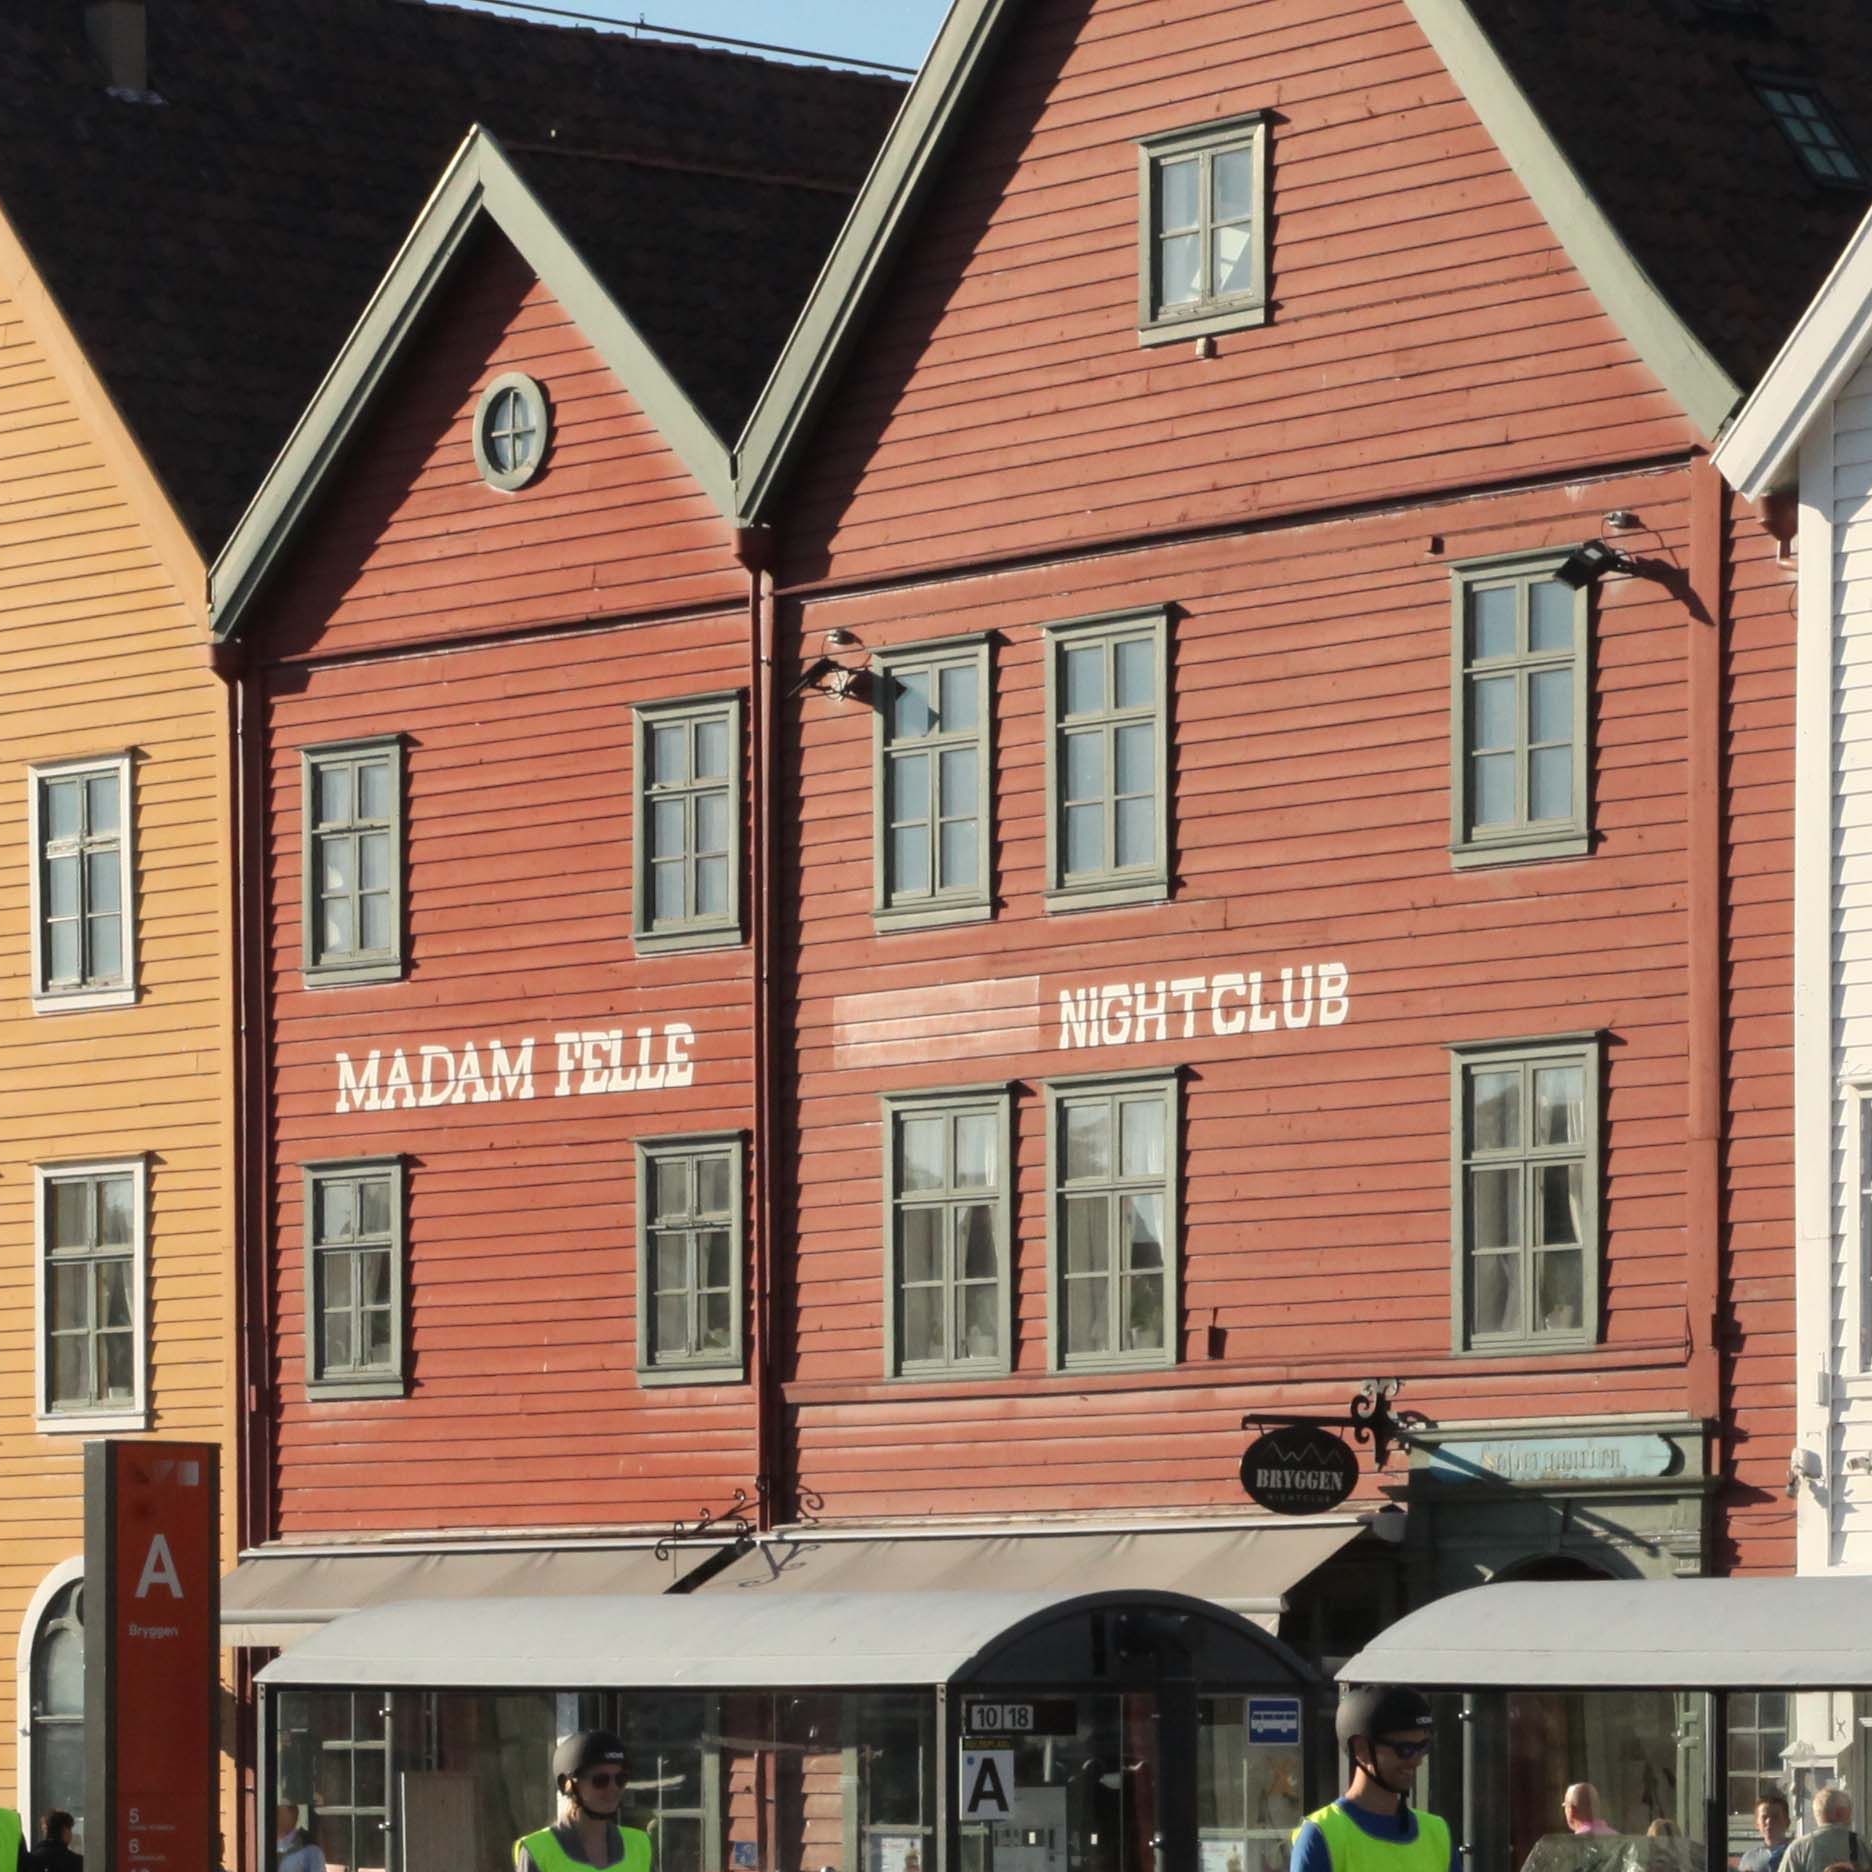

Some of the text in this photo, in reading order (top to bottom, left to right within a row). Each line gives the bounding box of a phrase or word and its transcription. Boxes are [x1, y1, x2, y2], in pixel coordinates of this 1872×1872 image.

[1058, 962, 1350, 1050] NIGHTCLUB
[335, 1022, 696, 1114] MADAM FELLE
[1256, 1468, 1345, 1491] BRYGGEN
[135, 1533, 184, 1599] A
[977, 1707, 1029, 1728] 10 18
[968, 1757, 1010, 1813] A
